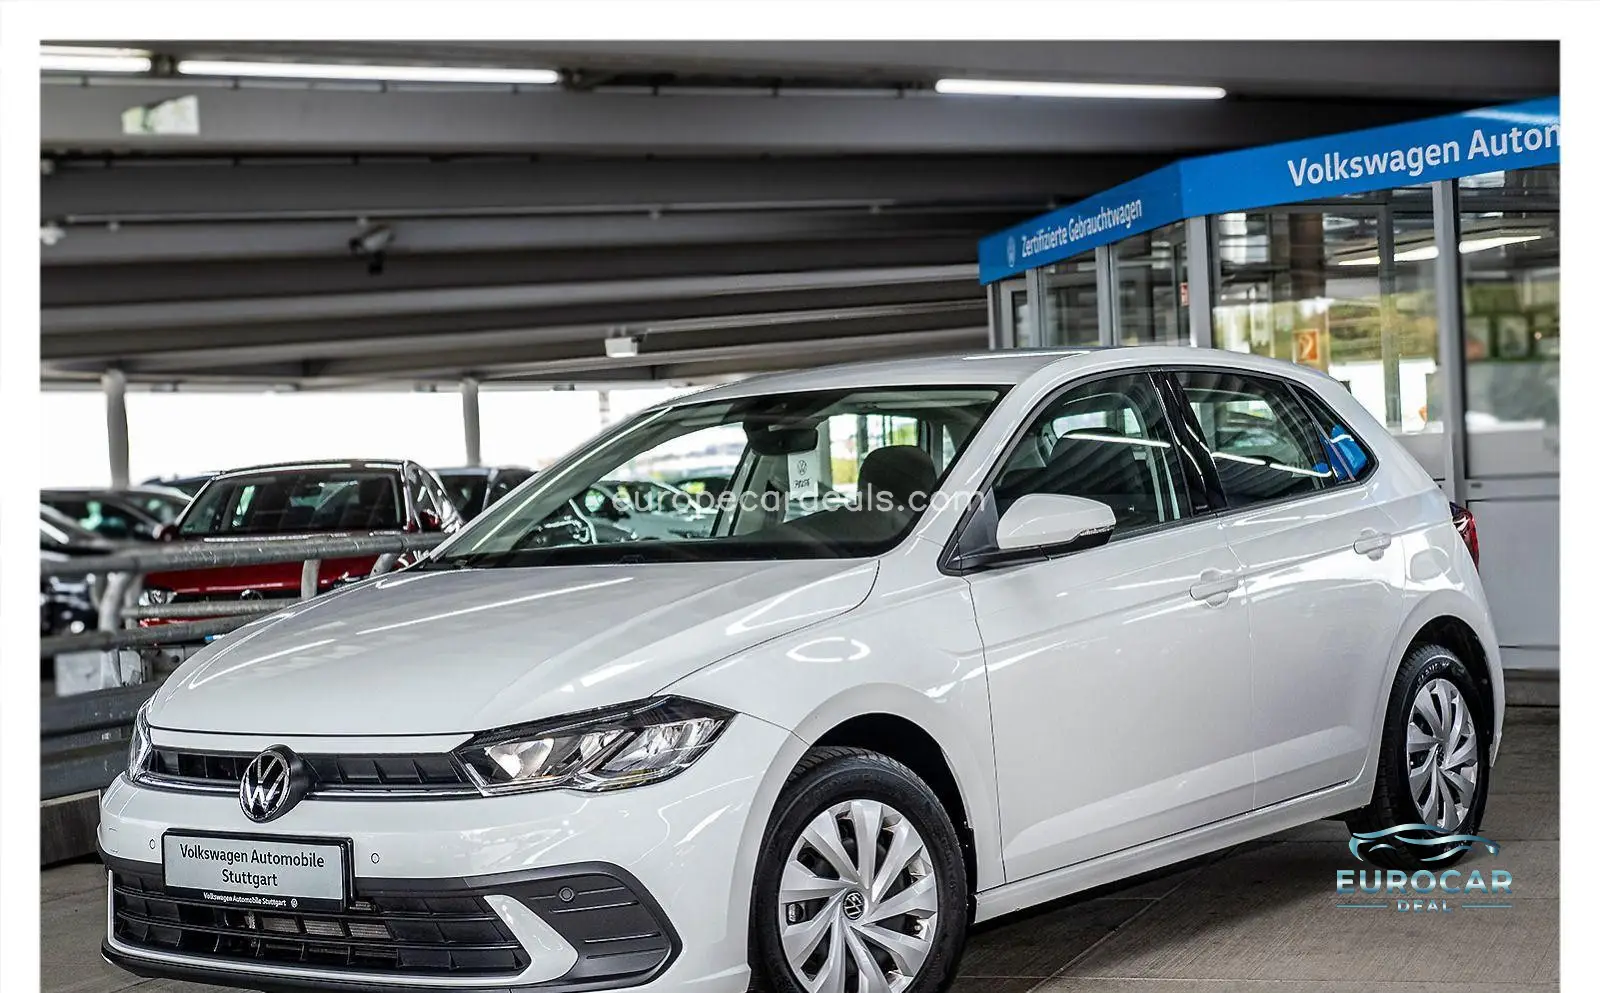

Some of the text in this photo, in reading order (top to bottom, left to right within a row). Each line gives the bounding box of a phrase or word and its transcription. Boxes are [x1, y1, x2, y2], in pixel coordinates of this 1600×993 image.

[1287, 141, 1460, 187] Volkswagen
[1021, 199, 1142, 258] Zertifizierte Gebrauchtwagen
[179, 843, 325, 868] Volkswagen Automobile
[222, 868, 278, 889] Stuttgart
[203, 891, 286, 908] Volkswagen Automobile Stuttgart
